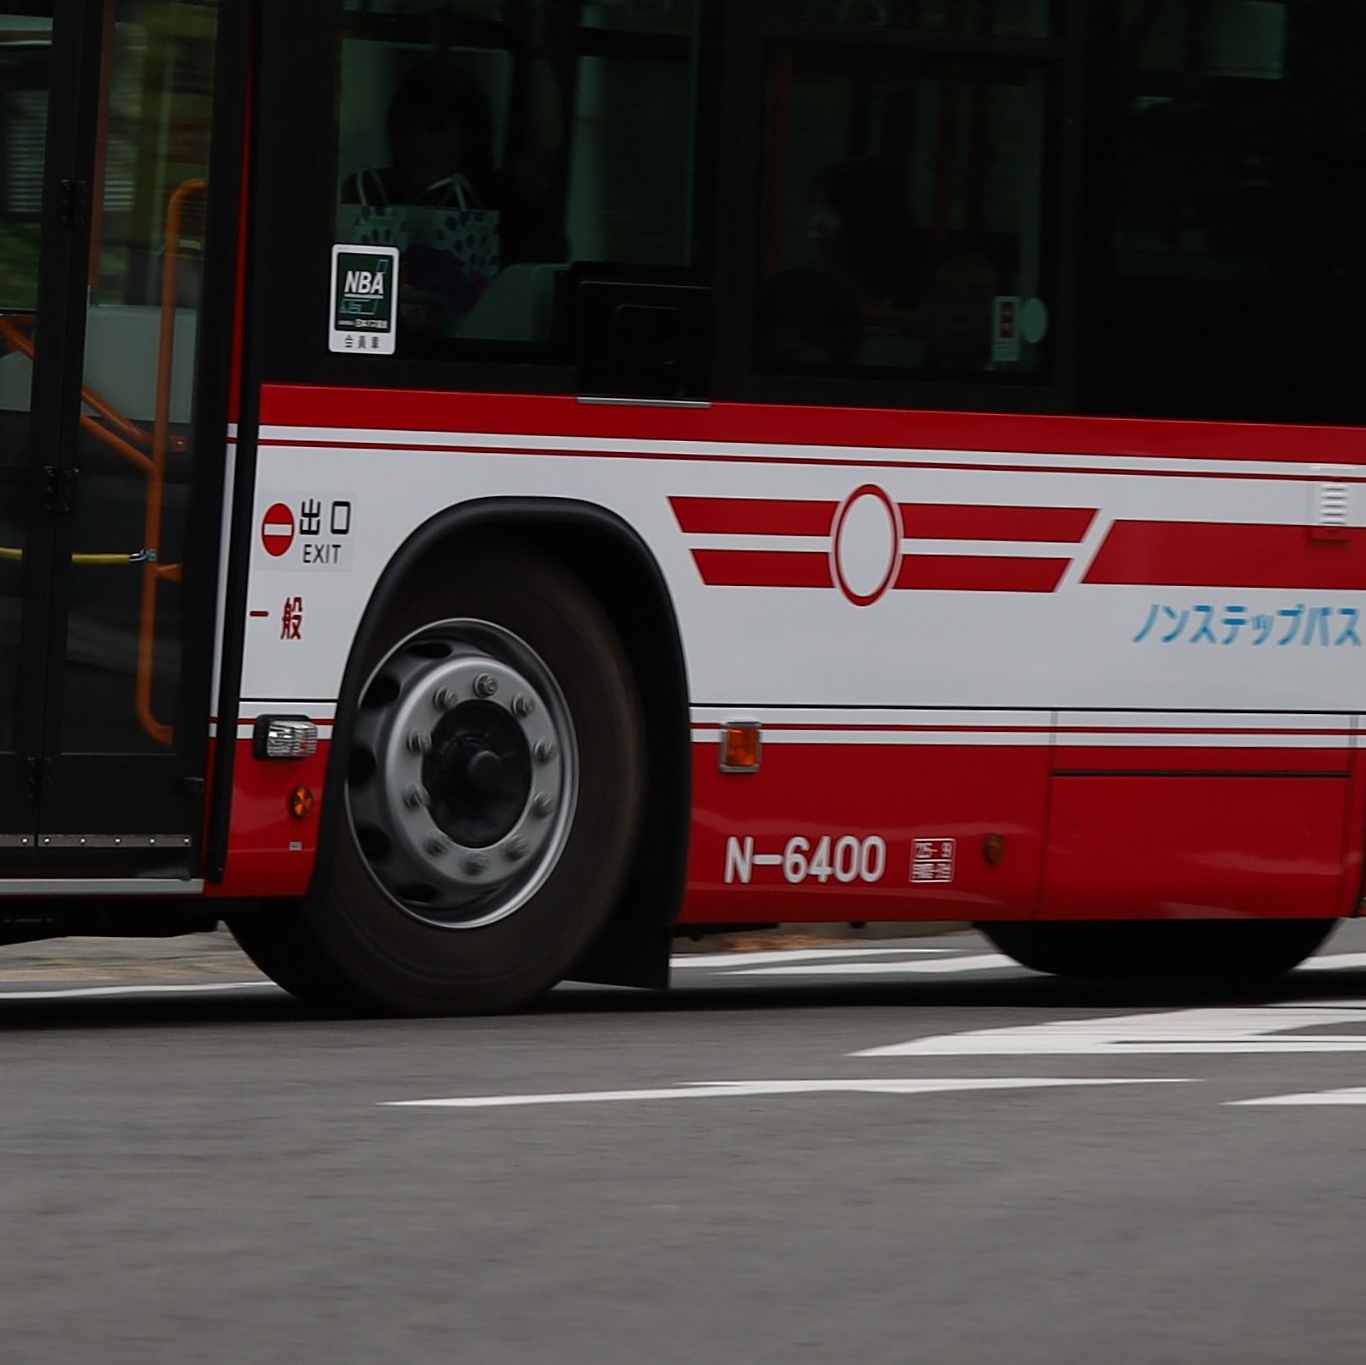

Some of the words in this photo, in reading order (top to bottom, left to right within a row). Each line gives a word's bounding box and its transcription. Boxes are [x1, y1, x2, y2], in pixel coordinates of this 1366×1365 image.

[344, 270, 384, 294] NBA
[299, 498, 351, 535] 出口
[303, 544, 342, 564] EXIT
[249, 597, 302, 640] 一般
[1132, 603, 1362, 646] ノンステップバス
[724, 835, 887, 883] N-6400
